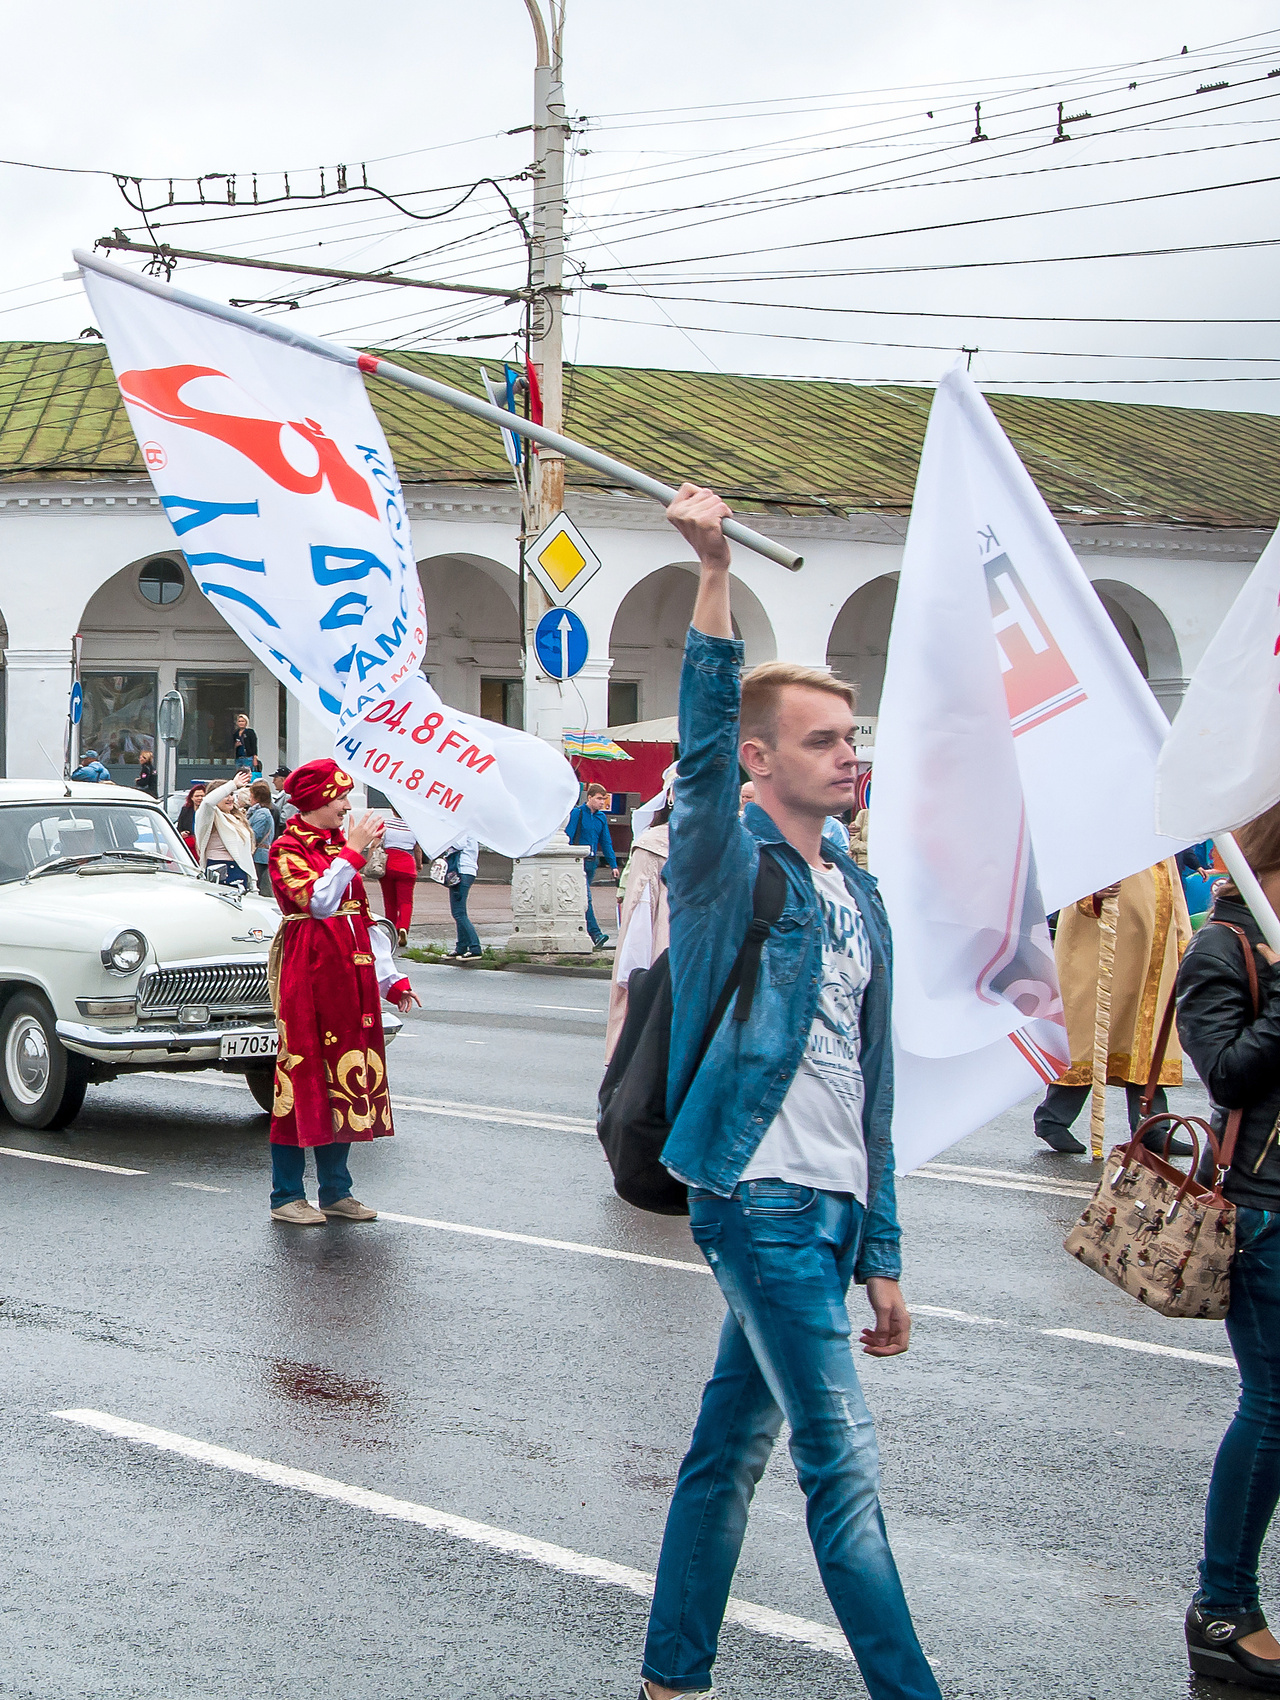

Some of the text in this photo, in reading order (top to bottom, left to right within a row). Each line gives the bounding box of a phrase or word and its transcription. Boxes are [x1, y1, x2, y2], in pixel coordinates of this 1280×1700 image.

[363, 699, 496, 774] 04.8 FM
[363, 748, 425, 791] 101.8
[425, 780, 464, 812] FM
[227, 1035, 279, 1055] Н703М
